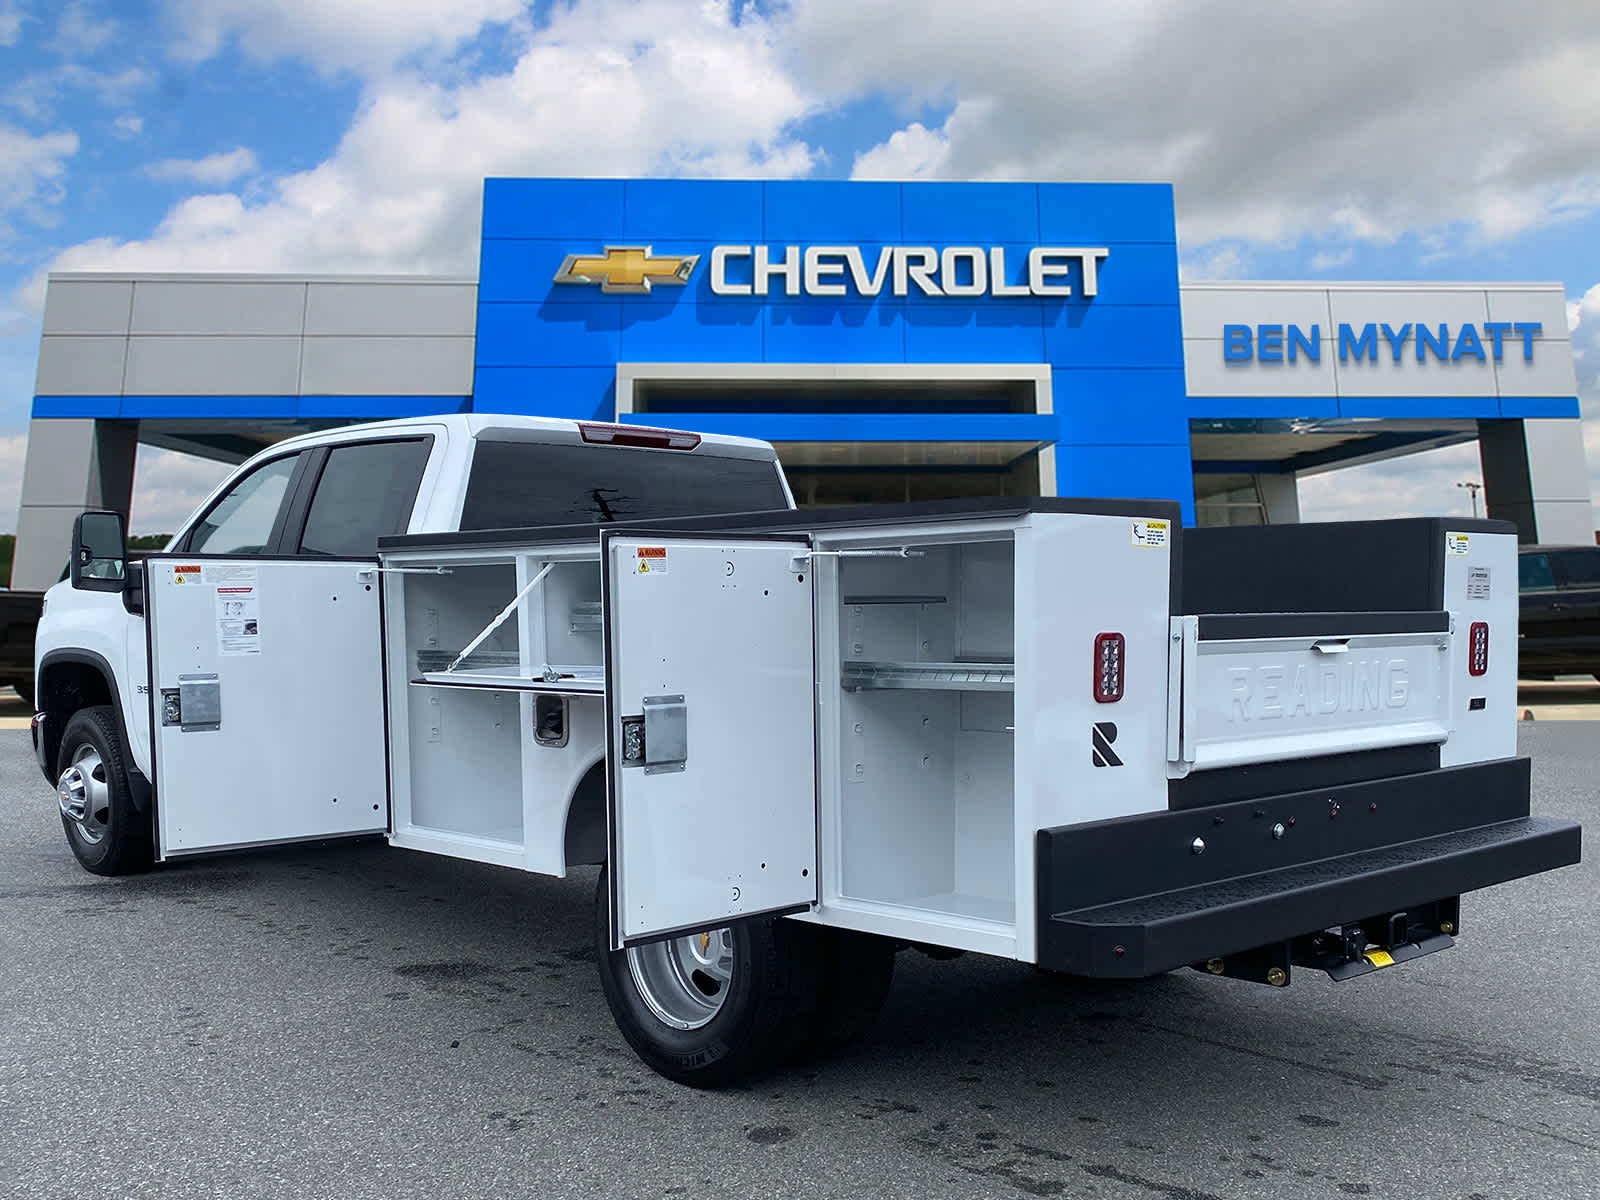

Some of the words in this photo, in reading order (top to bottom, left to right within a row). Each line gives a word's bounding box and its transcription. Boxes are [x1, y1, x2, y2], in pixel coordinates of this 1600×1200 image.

[710, 244, 1110, 298] CHEVROLET
[1223, 323, 1321, 364] BEN
[1338, 321, 1543, 364] MYNATT
[1226, 659, 1410, 723] READING
